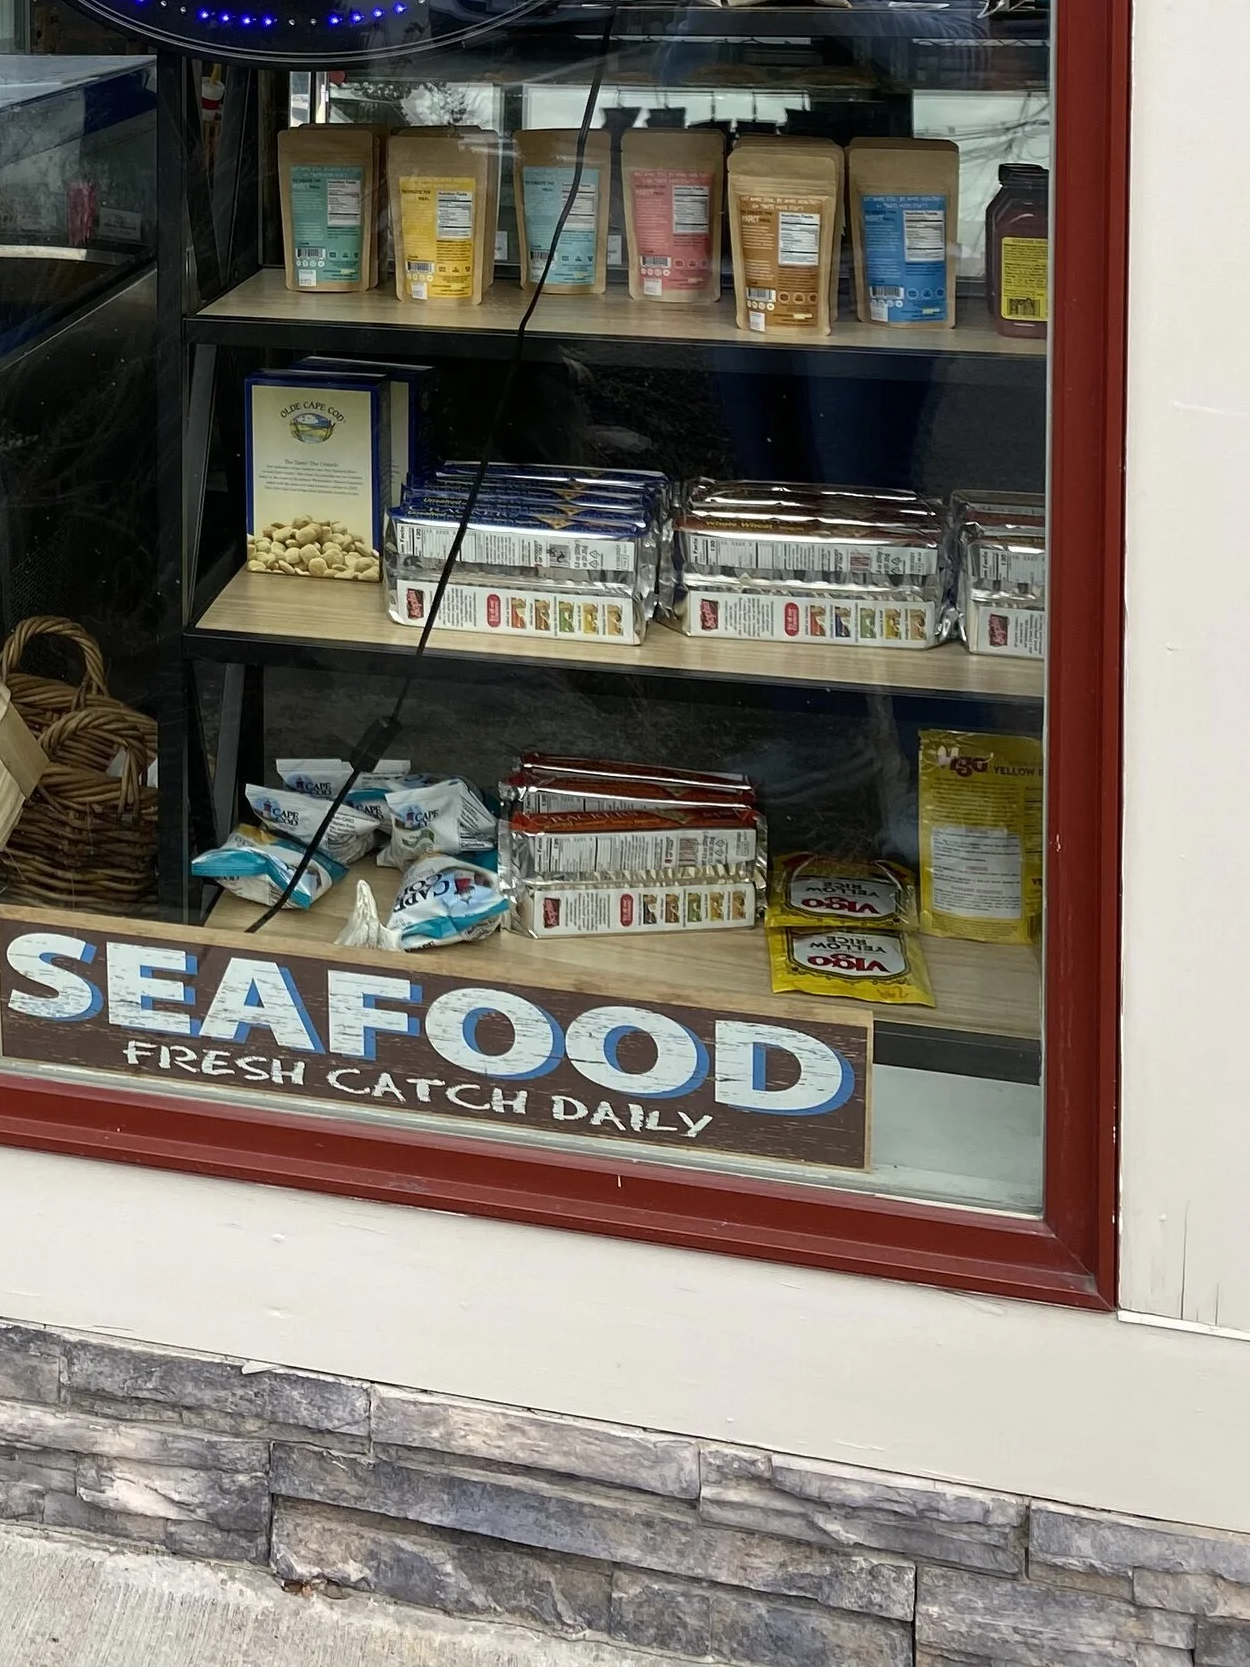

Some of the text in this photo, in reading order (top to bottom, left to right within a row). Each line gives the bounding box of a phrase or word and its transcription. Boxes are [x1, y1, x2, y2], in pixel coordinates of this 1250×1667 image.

[279, 400, 345, 422] OLDE CAPE COD
[305, 782, 332, 793] CAPE
[272, 807, 300, 822] CAPE
[414, 809, 440, 822] CAPE
[825, 936, 867, 946] RICE
[809, 942, 887, 955] YELLOW
[5, 931, 854, 1117] SEAFOOD
[124, 1040, 715, 1140] FRESH CATCH DAILY
